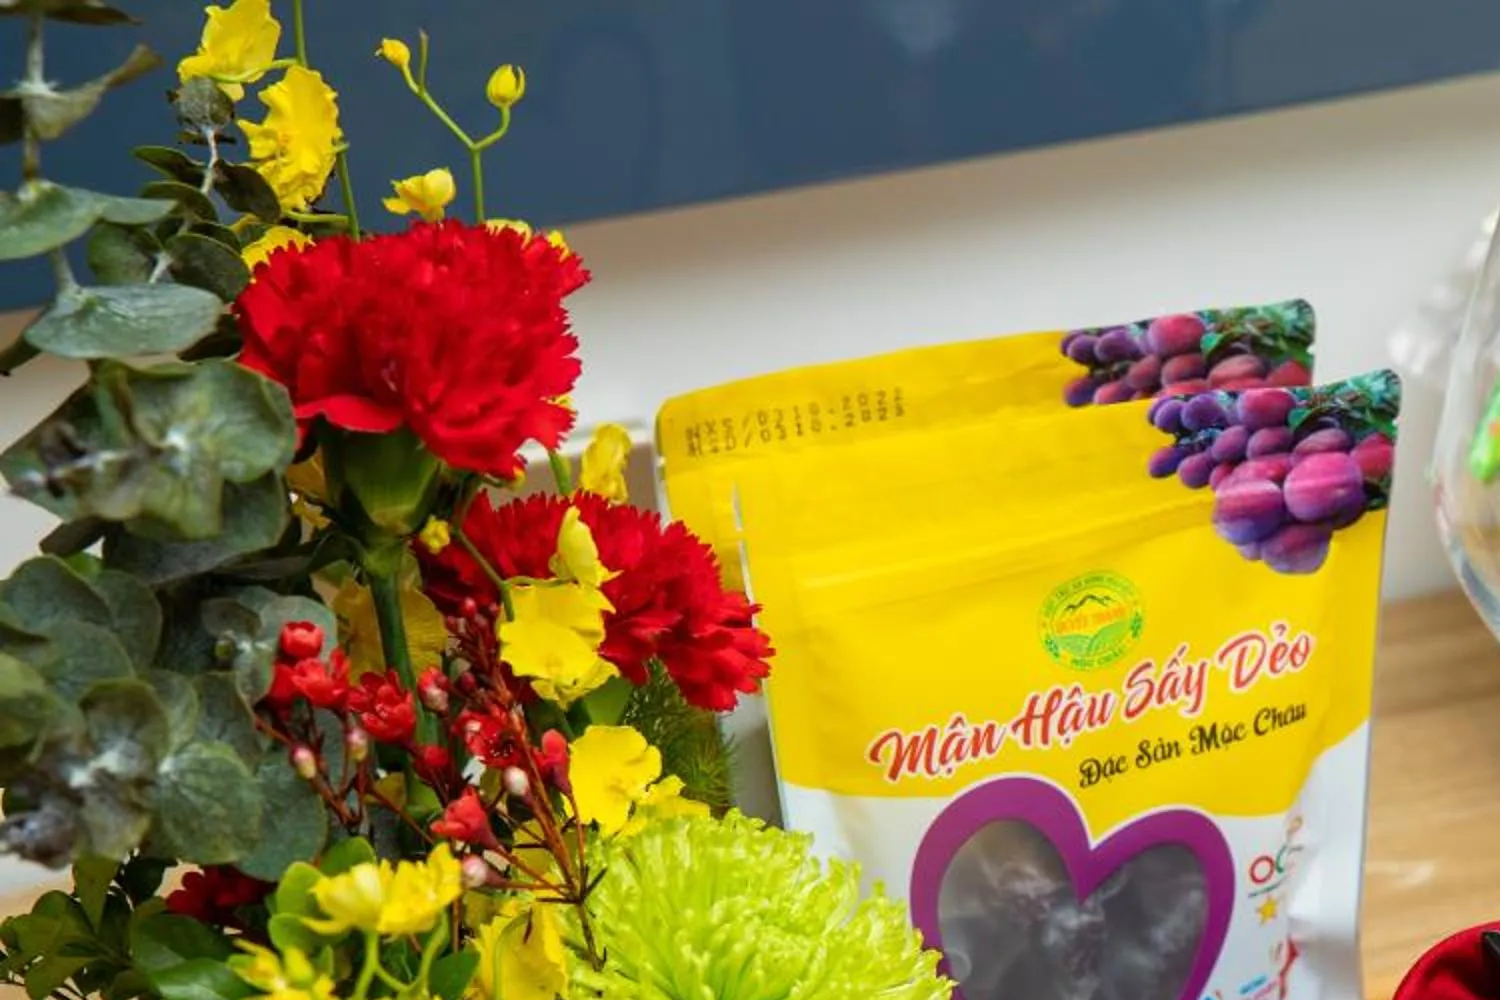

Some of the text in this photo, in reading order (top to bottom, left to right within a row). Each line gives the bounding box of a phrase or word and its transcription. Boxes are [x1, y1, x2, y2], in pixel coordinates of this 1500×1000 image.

[869, 623, 1312, 781] Mận Hậu Sấy Dẻo
